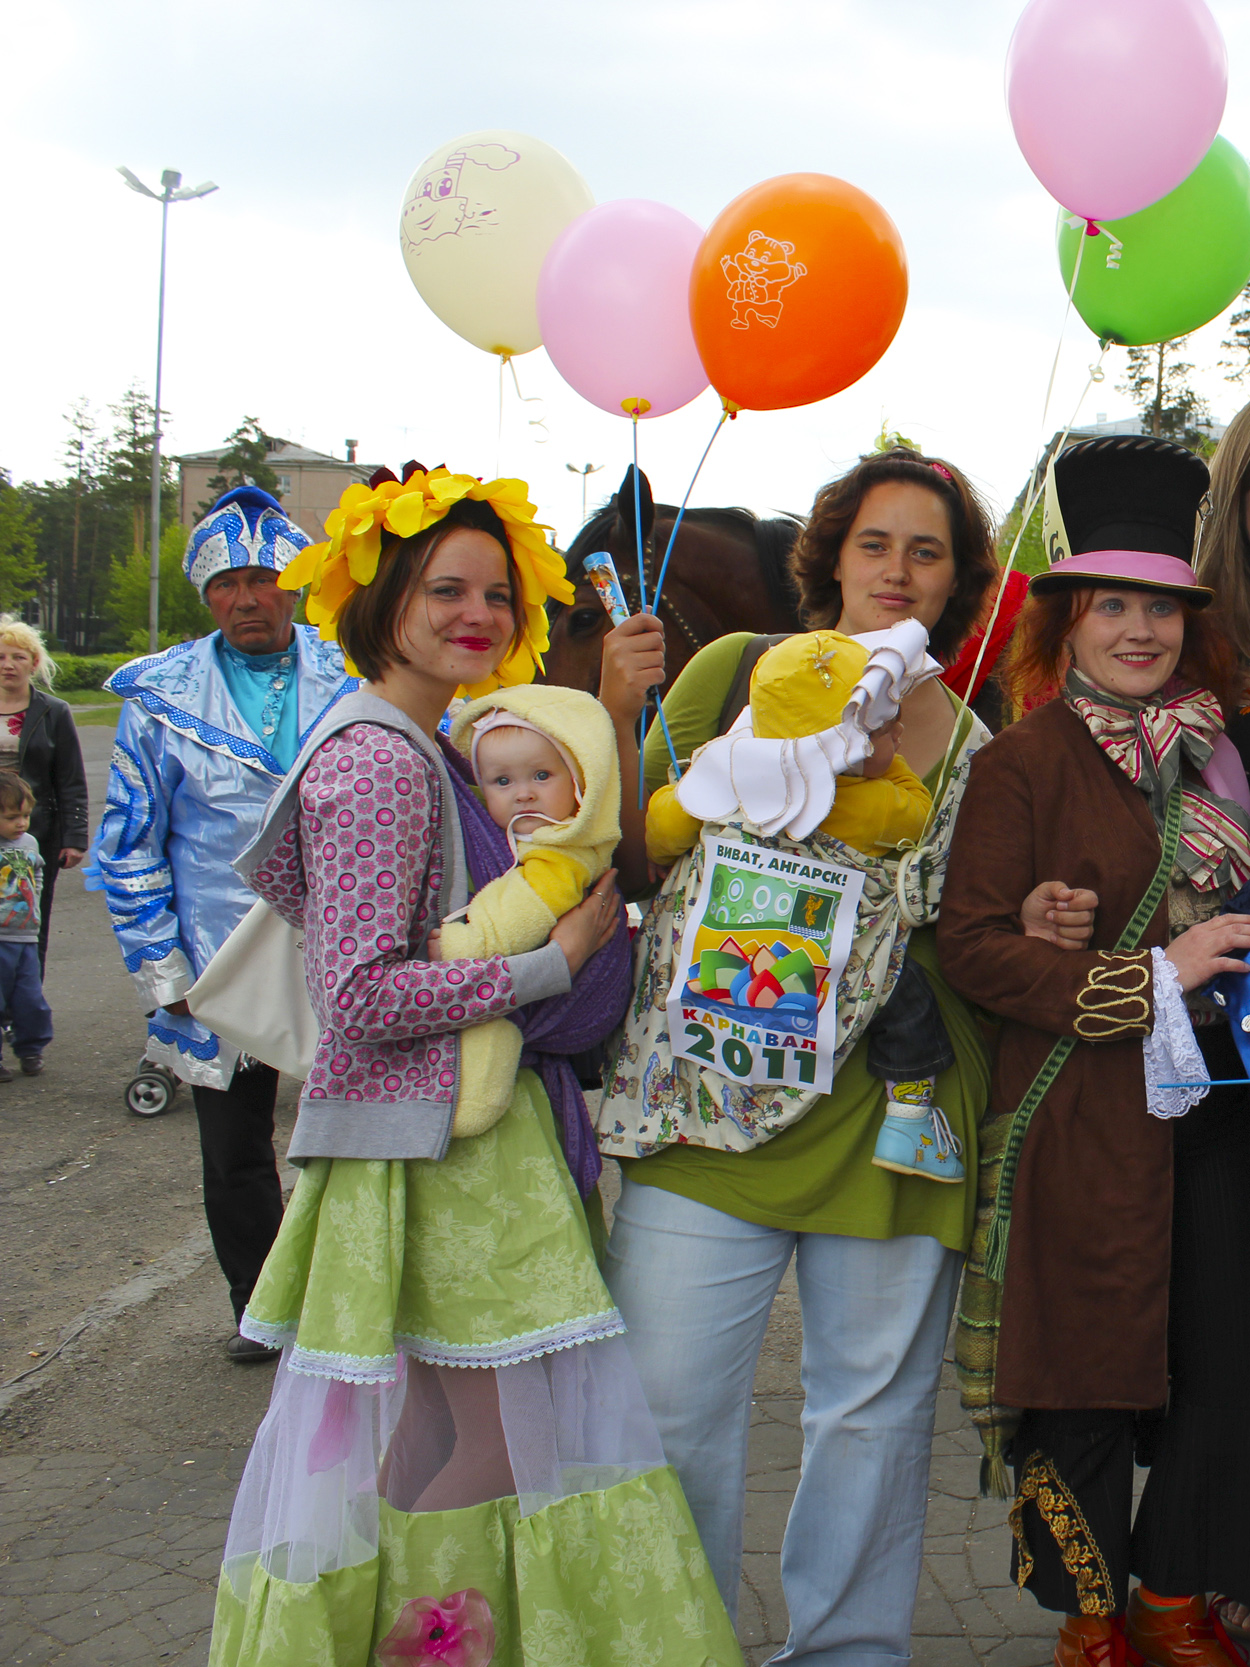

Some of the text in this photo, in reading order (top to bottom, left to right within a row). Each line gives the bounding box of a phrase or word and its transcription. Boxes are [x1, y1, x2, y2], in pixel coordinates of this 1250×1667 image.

[716, 844, 849, 887] ВИВАТ, АНГАРСК!
[682, 1008, 817, 1052] КАРНАВАЛ
[684, 1022, 817, 1084] 2011
